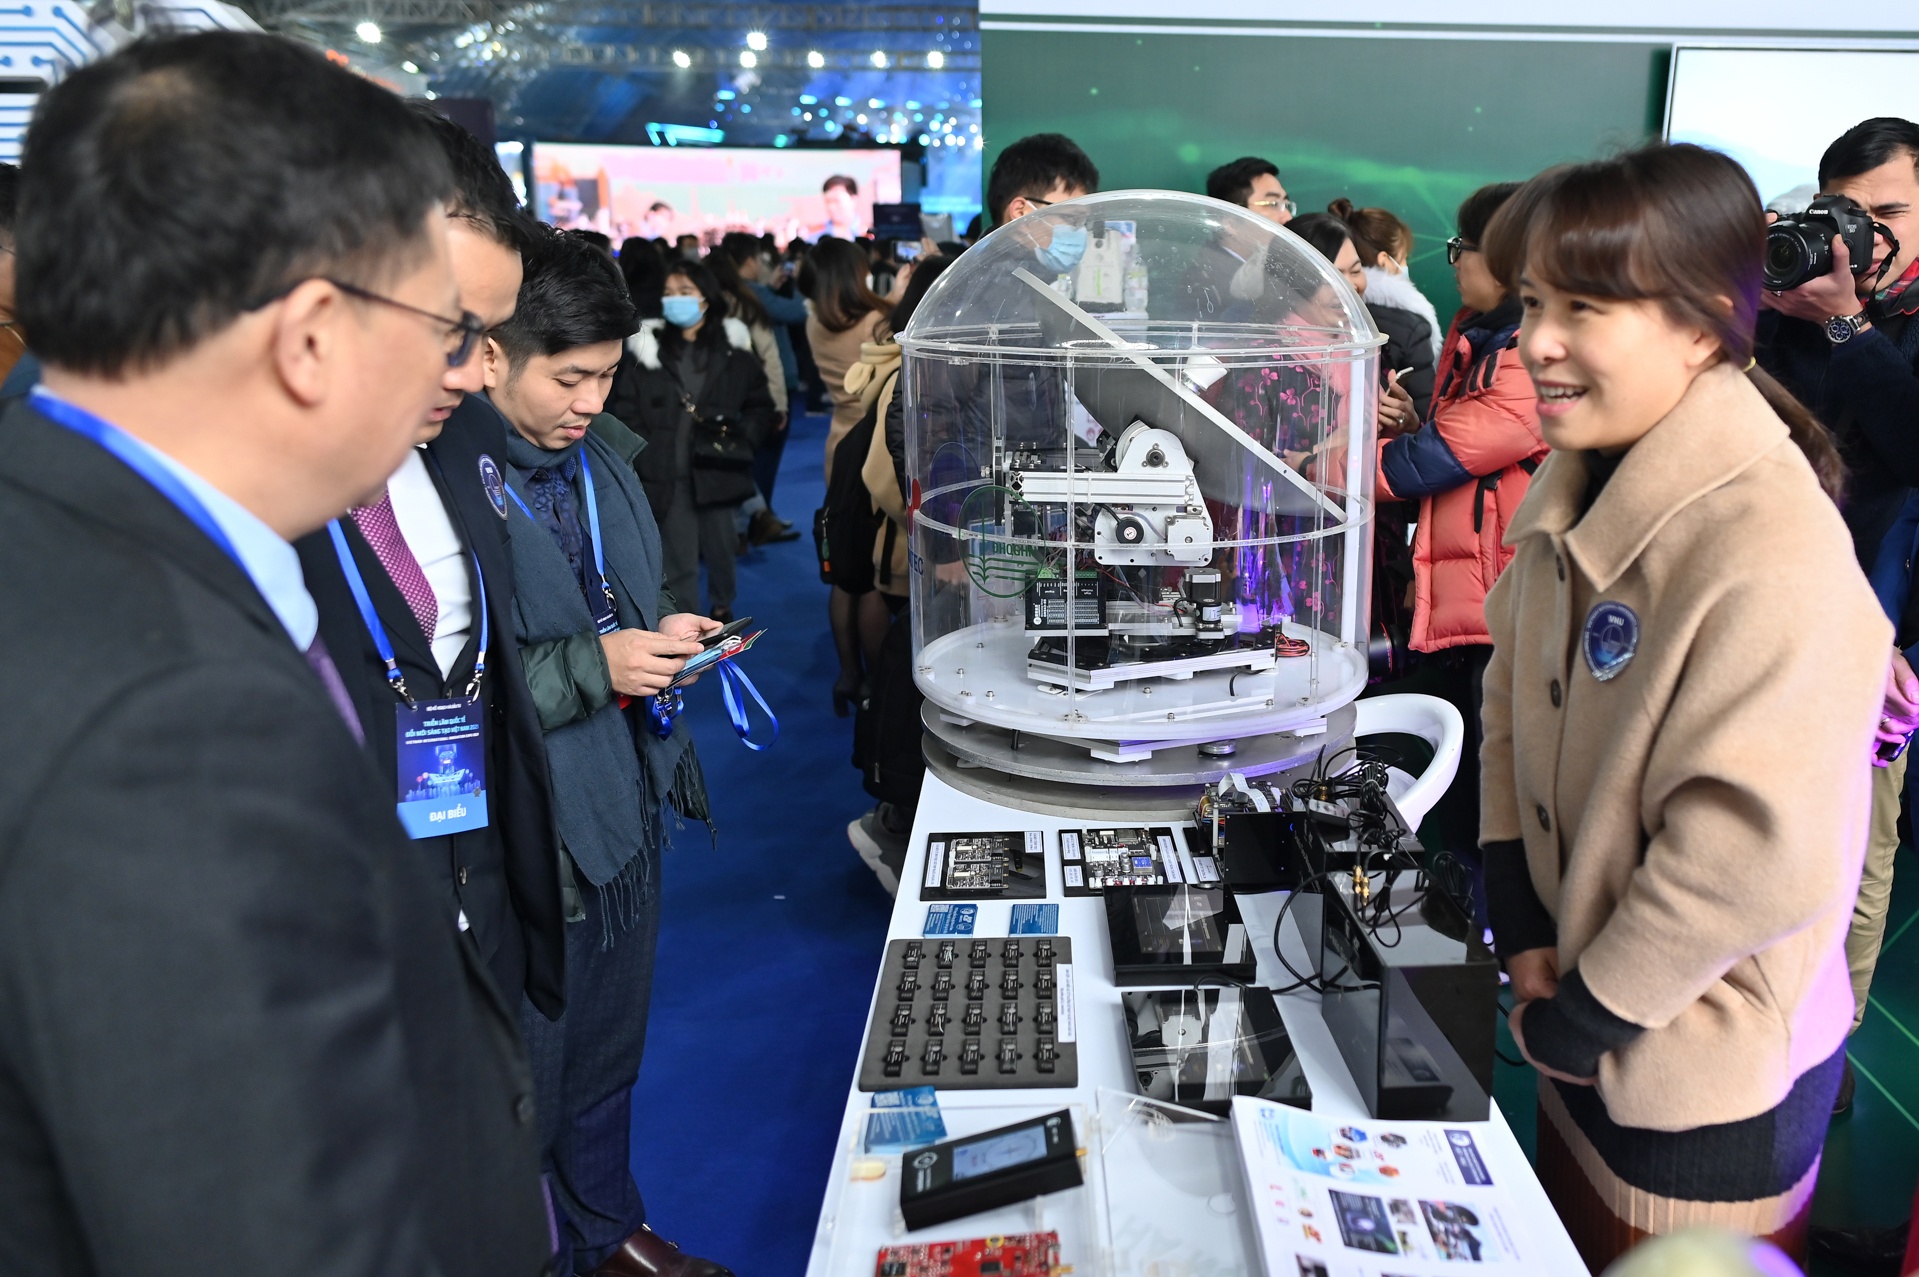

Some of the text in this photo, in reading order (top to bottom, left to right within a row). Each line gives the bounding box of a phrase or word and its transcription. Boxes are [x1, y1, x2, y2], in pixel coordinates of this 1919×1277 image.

[1607, 614, 1625, 626] VNU
[429, 803, 467, 822] ĐẠI BIỂU
